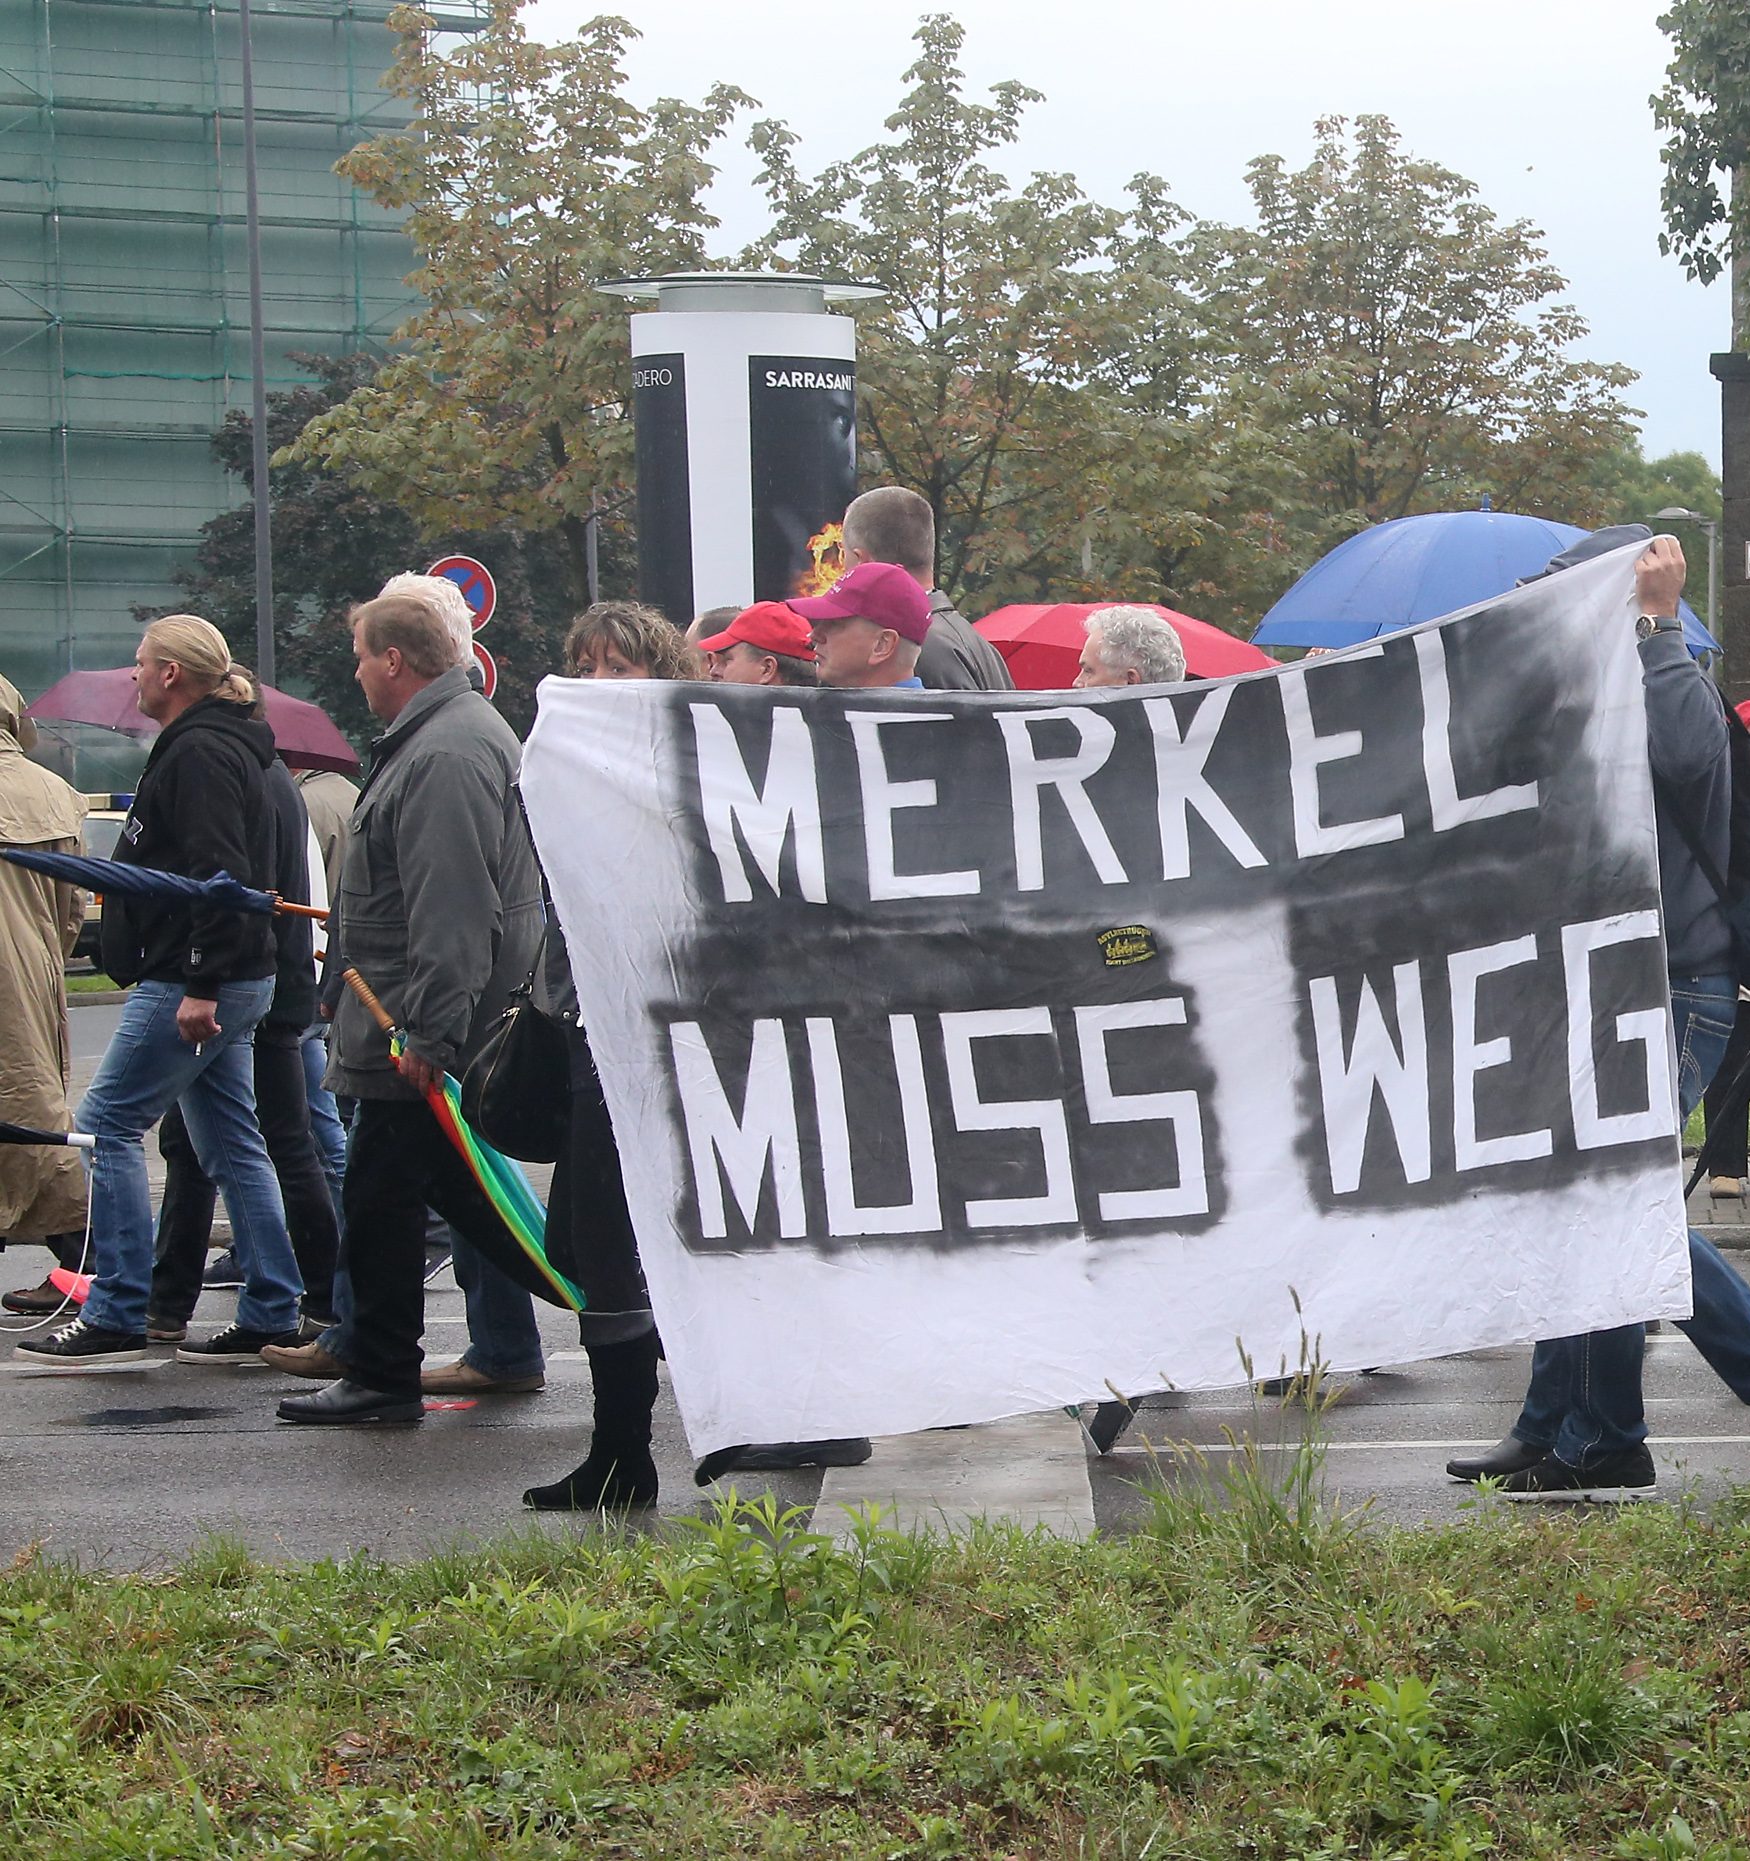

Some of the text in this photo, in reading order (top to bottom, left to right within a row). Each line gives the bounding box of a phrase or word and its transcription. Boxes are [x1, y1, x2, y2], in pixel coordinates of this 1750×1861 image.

[765, 370, 852, 391] SARRASANI
[686, 627, 1538, 904] MERKEL
[668, 909, 1678, 1241] MUSS WEG
